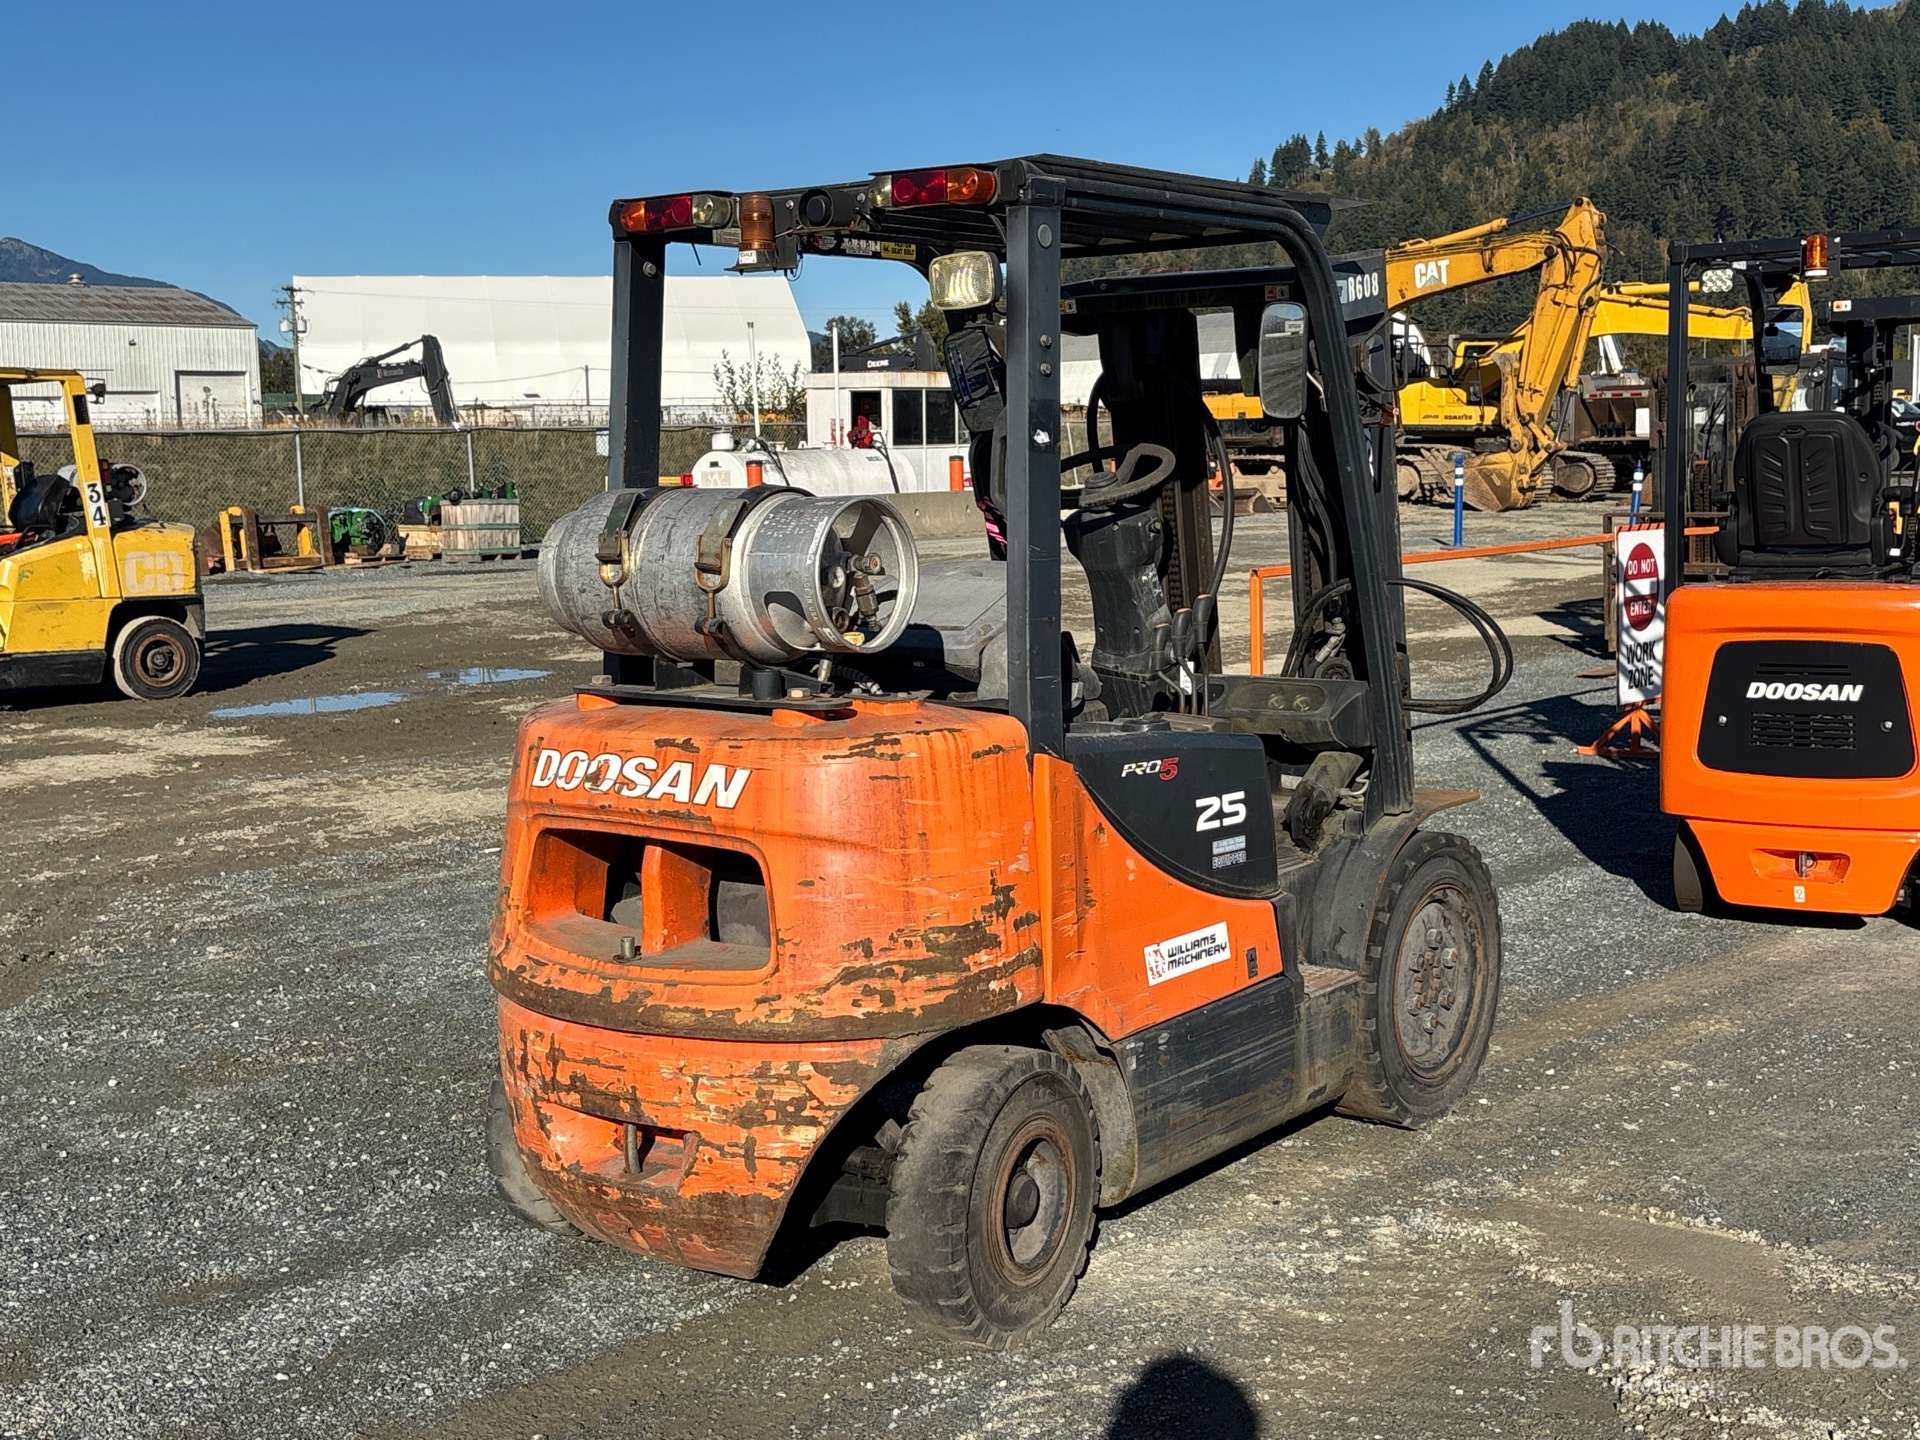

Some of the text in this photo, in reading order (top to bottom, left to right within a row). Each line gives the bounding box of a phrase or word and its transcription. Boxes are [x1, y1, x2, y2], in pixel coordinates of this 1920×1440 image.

[1414, 259, 1450, 289] CAT
[1348, 272, 1379, 302] R608
[1628, 558, 1655, 575] DO NOT
[1630, 600, 1652, 616] ENTER
[1626, 640, 1656, 665] WORK
[1628, 667, 1654, 689] ZONE
[1746, 682, 1864, 701] DOOSAN
[531, 748, 753, 809] DOOSAN
[1196, 791, 1247, 832] 25
[1212, 850, 1247, 869] EQUIPPED
[1168, 933, 1216, 958] WILLIAMS
[1168, 942, 1227, 971] MACHINERY
